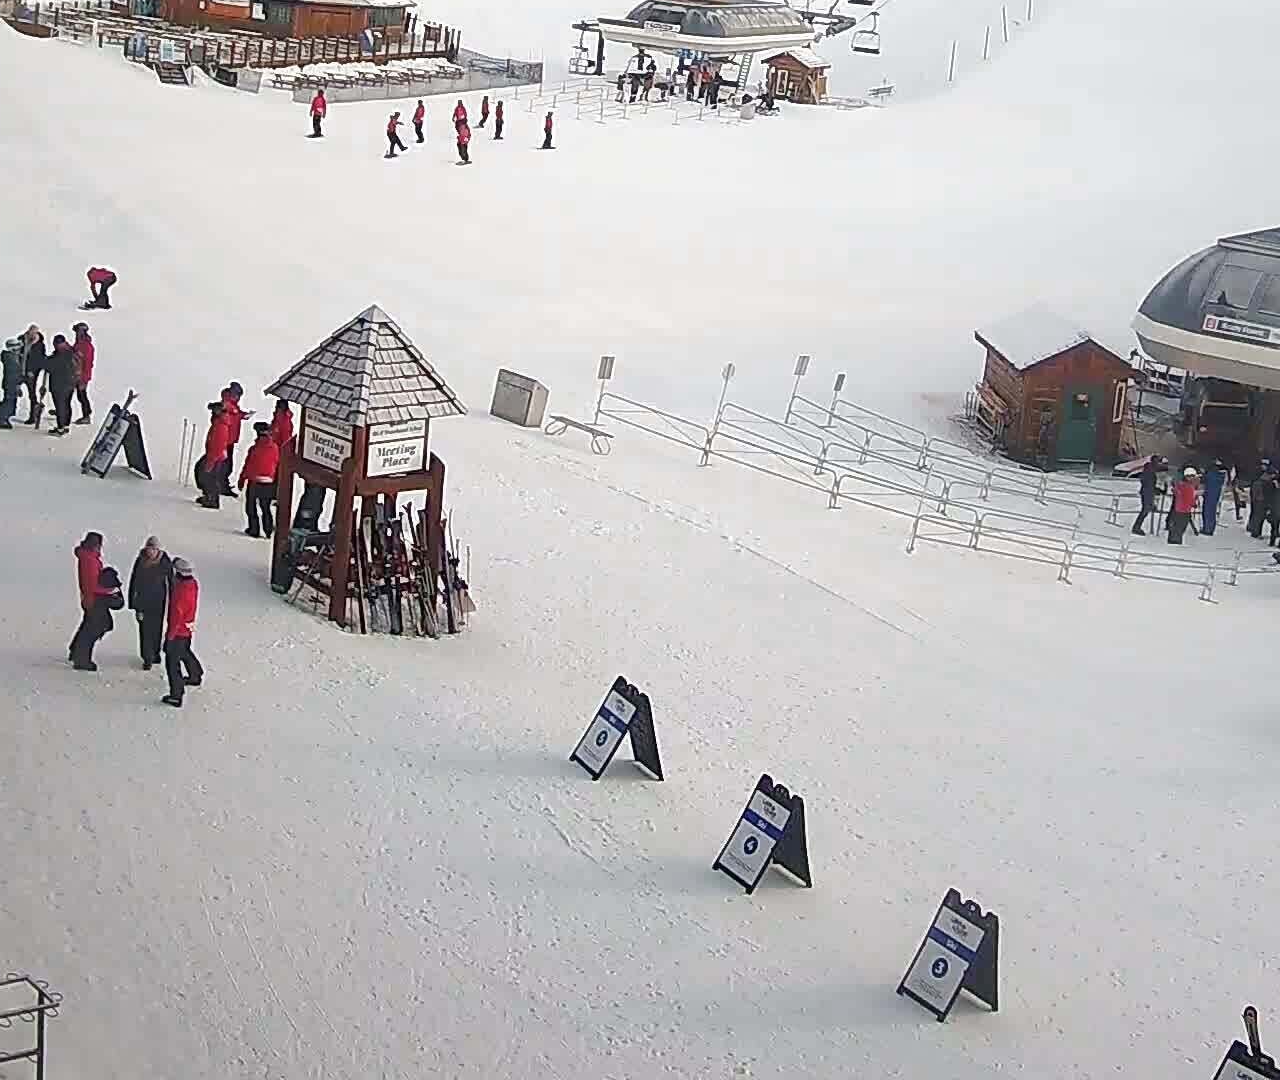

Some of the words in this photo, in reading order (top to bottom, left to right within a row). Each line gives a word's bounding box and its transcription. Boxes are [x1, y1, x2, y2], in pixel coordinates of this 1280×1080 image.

[311, 432, 345, 455] Meeting
[377, 444, 417, 456] Meeting
[314, 445, 341, 462] Place
[382, 456, 410, 468] Place
[934, 961, 945, 974] 3
